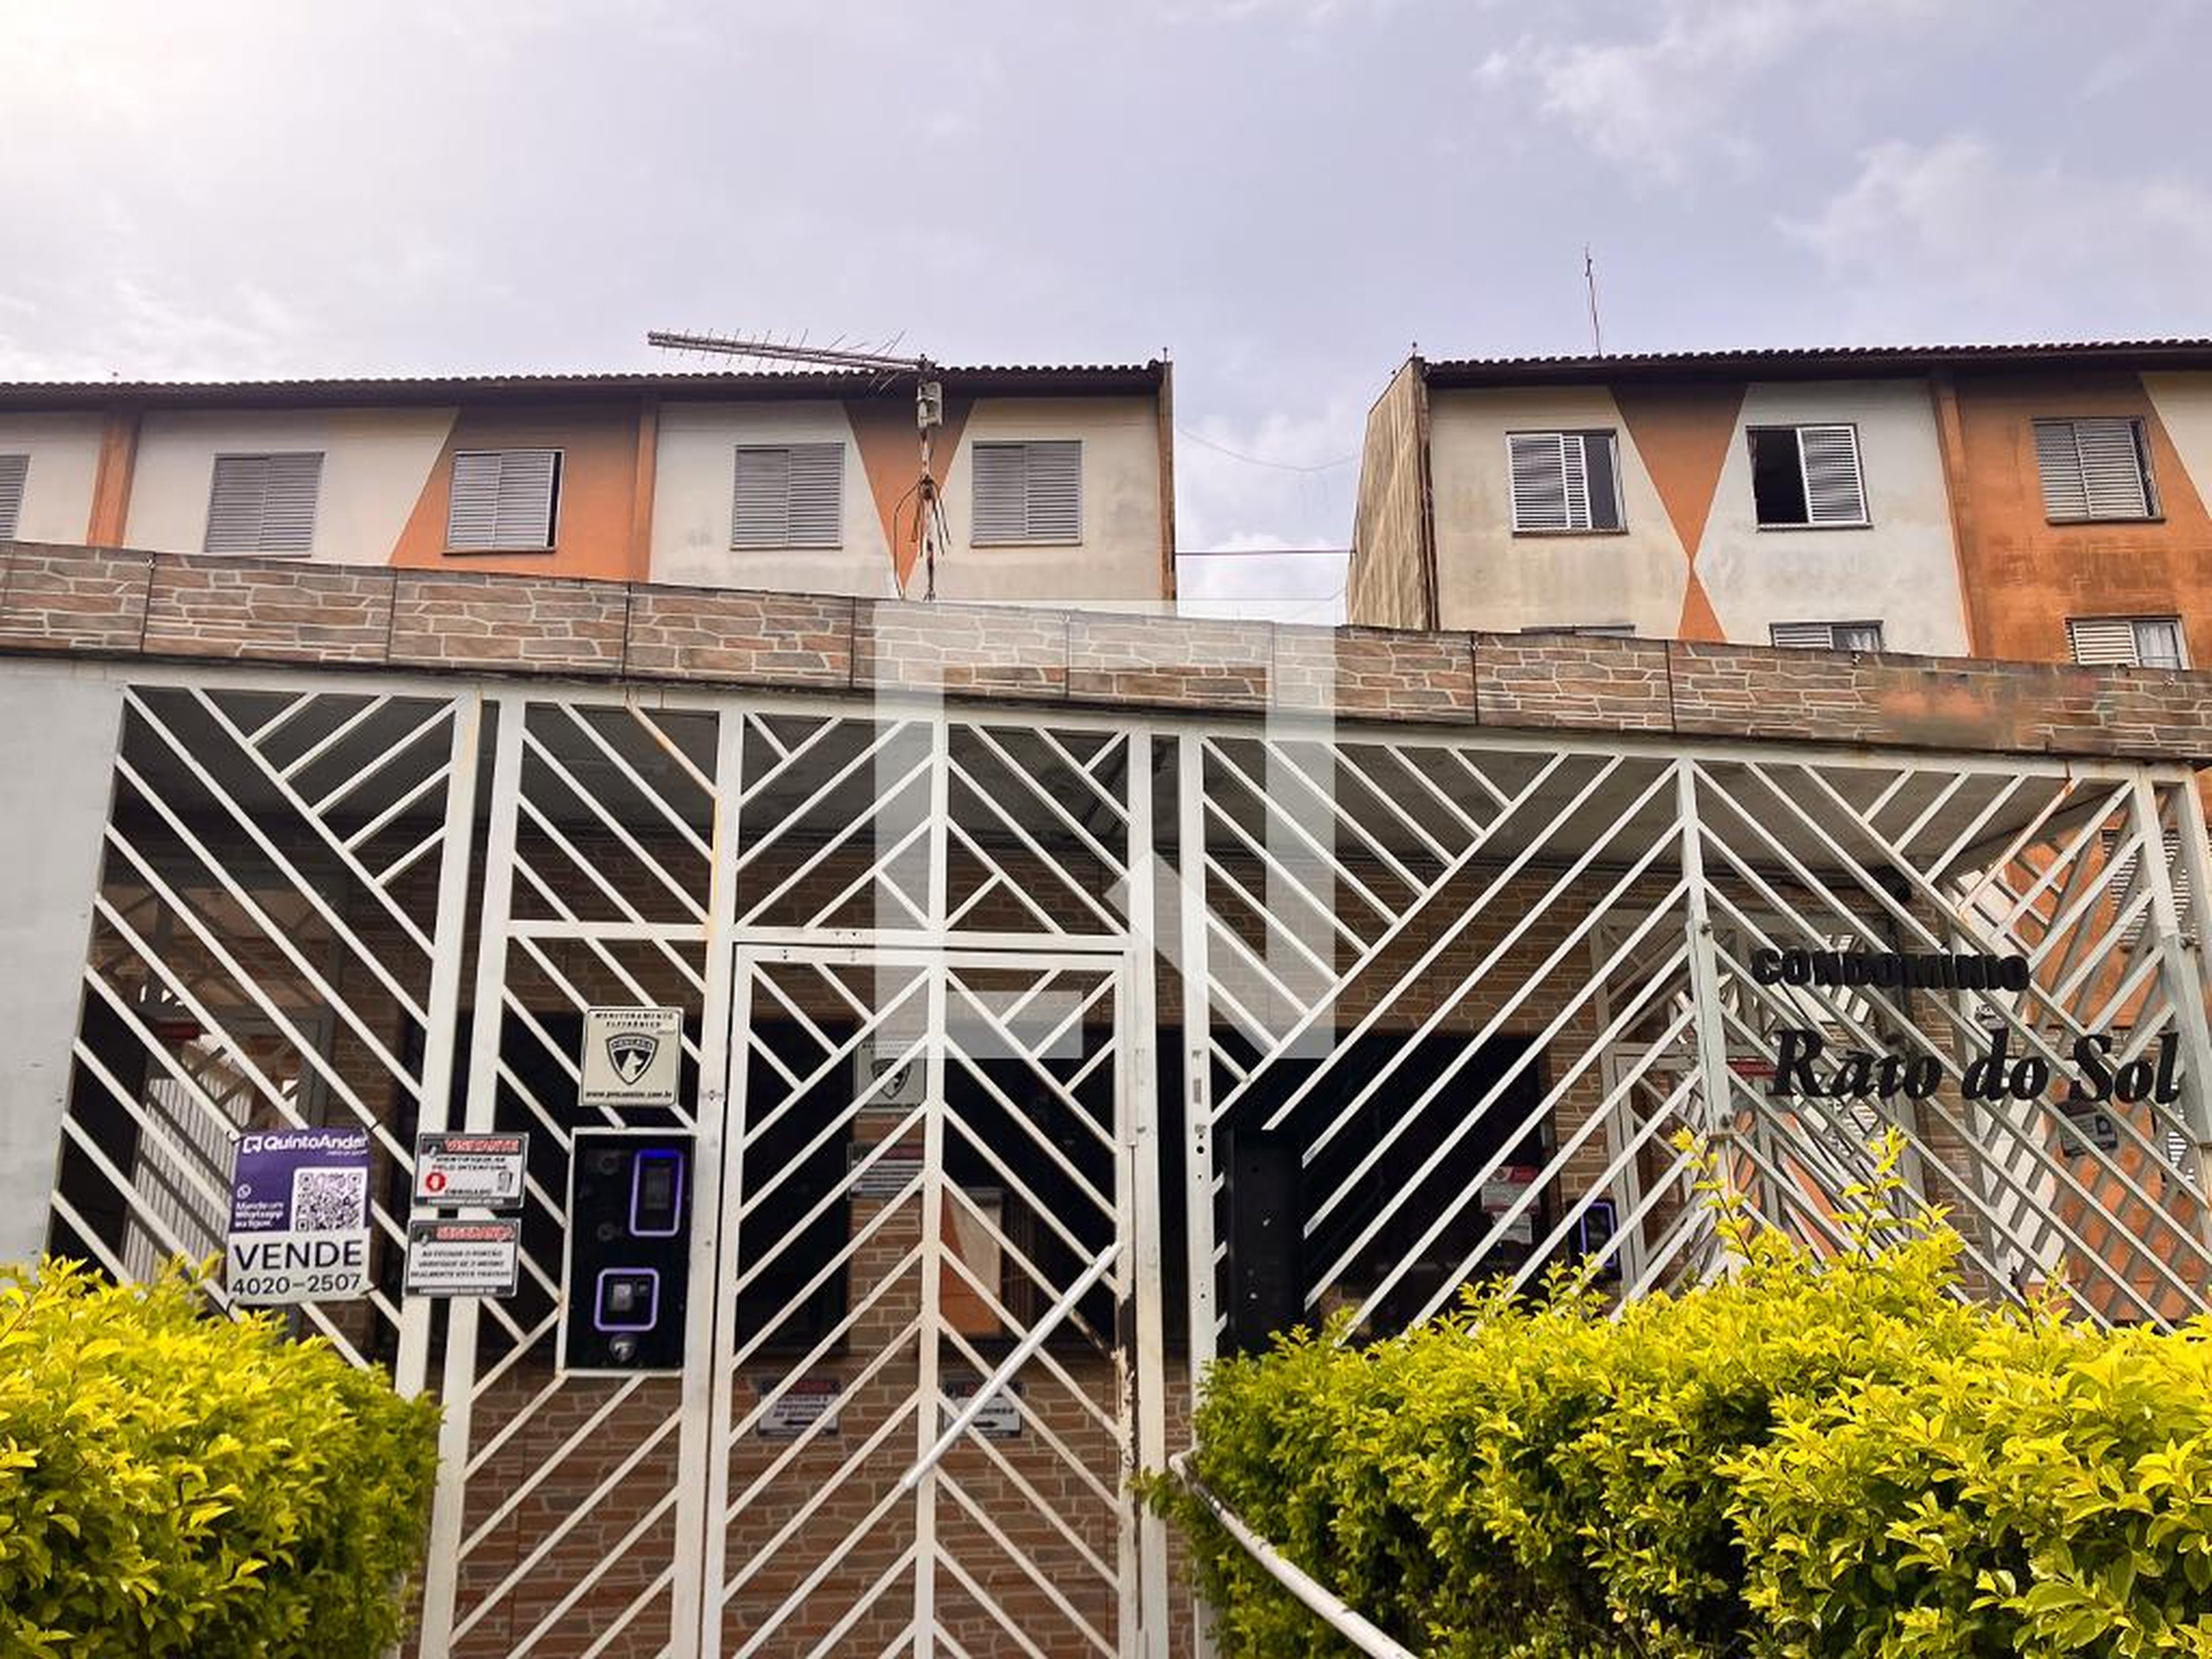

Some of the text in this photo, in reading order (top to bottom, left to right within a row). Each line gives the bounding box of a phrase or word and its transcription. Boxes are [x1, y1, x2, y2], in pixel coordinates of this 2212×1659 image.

[1961, 1028, 2048, 1100] do
[2070, 1032, 2180, 1103] Sol
[263, 1134, 368, 1150] QuintoAndar
[234, 1240, 362, 1271] VENDE
[232, 1273, 361, 1296] 4020-2507
